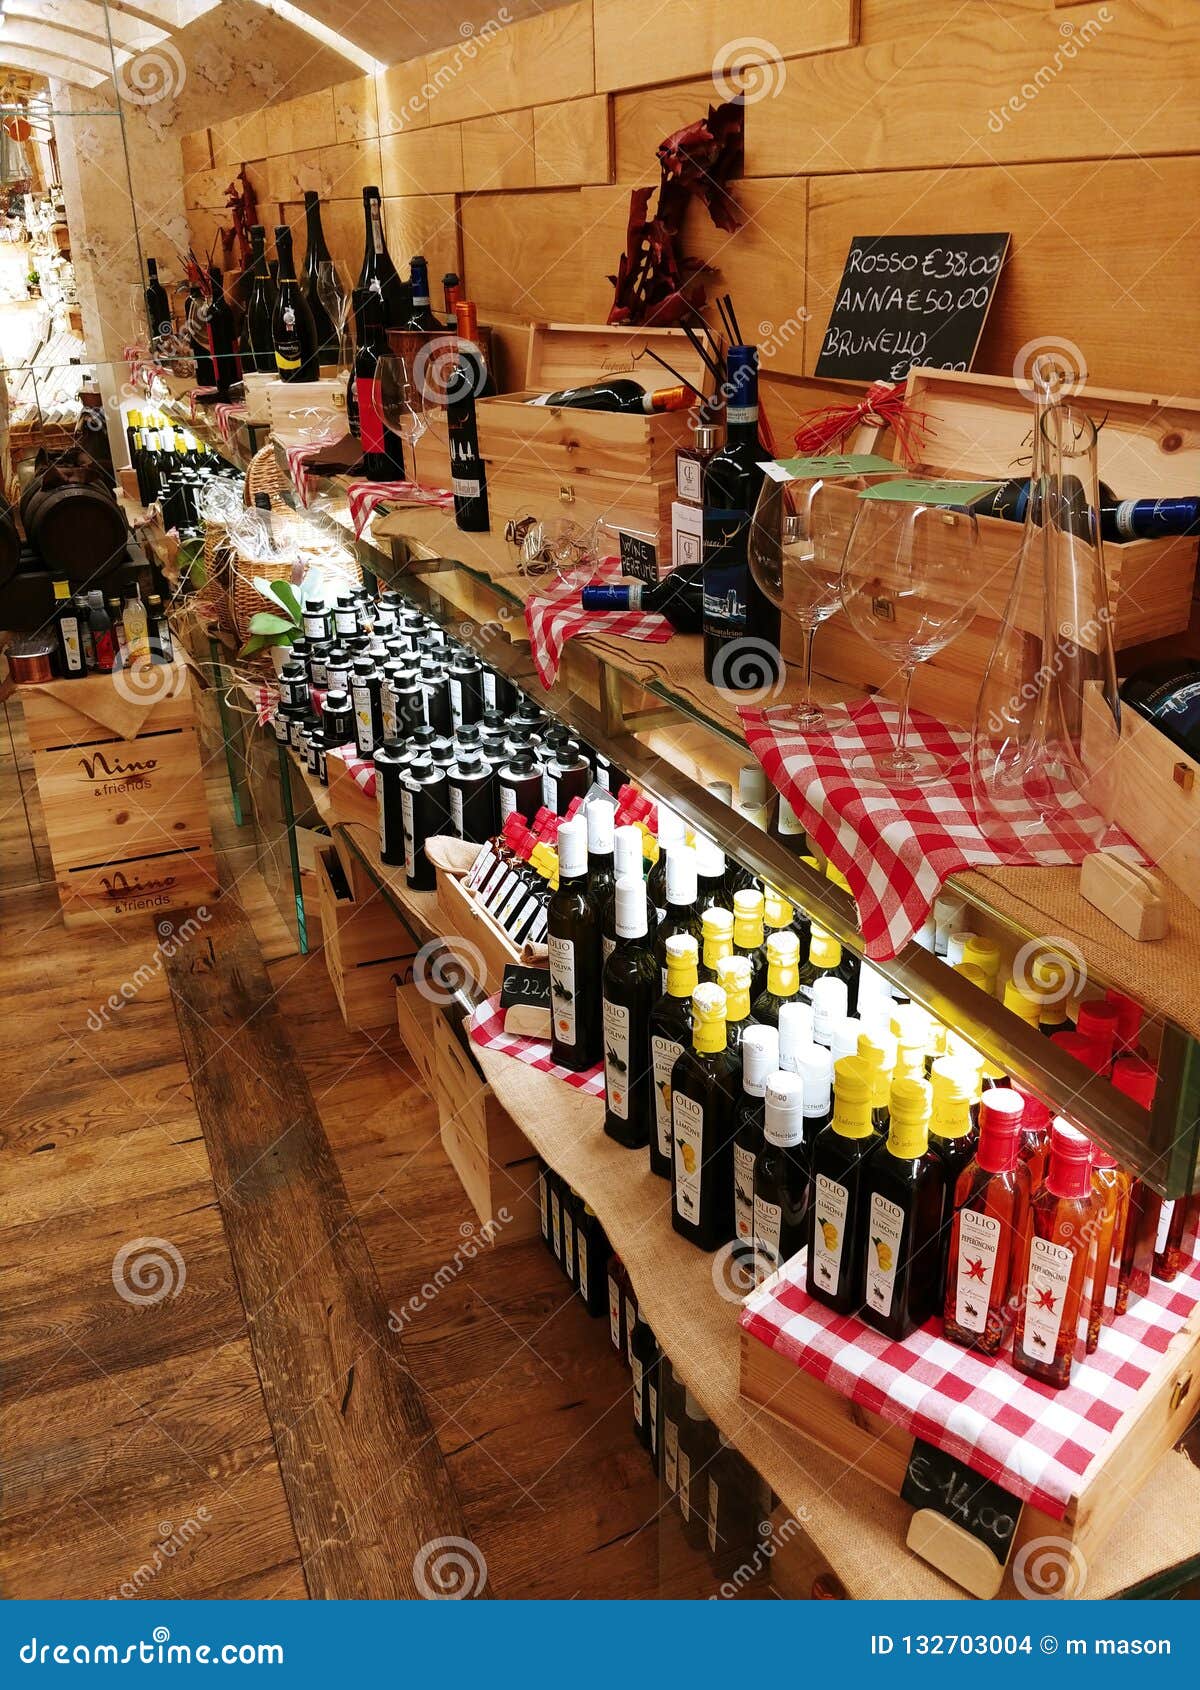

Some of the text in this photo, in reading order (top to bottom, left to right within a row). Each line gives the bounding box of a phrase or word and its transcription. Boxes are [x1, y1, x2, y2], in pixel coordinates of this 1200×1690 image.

[849, 249, 919, 274] ROSSO
[836, 285, 990, 315] ANNA €50,00
[822, 327, 928, 358] BRUNELLO
[622, 537, 648, 560] WINE
[622, 554, 657, 581] PERFUME
[78, 752, 159, 779] Nino
[103, 779, 153, 796] friends
[100, 871, 177, 898] Nino
[123, 894, 171, 912] friends
[549, 937, 570, 951] OLIO
[604, 1003, 625, 1018] OLIO
[654, 1039, 681, 1056] OLIO
[675, 1094, 700, 1116] OLIO
[675, 1119, 700, 1138] LIMONE
[818, 1178, 846, 1198] OLIO
[755, 1198, 778, 1216] OLIO
[818, 1199, 844, 1218] LIMONE
[873, 1196, 901, 1218] OLIO
[872, 1218, 899, 1239] LIMONE
[964, 1212, 996, 1231] OLIO
[961, 1234, 996, 1253] PEPERONCINO
[1035, 1241, 1068, 1261] OLIO
